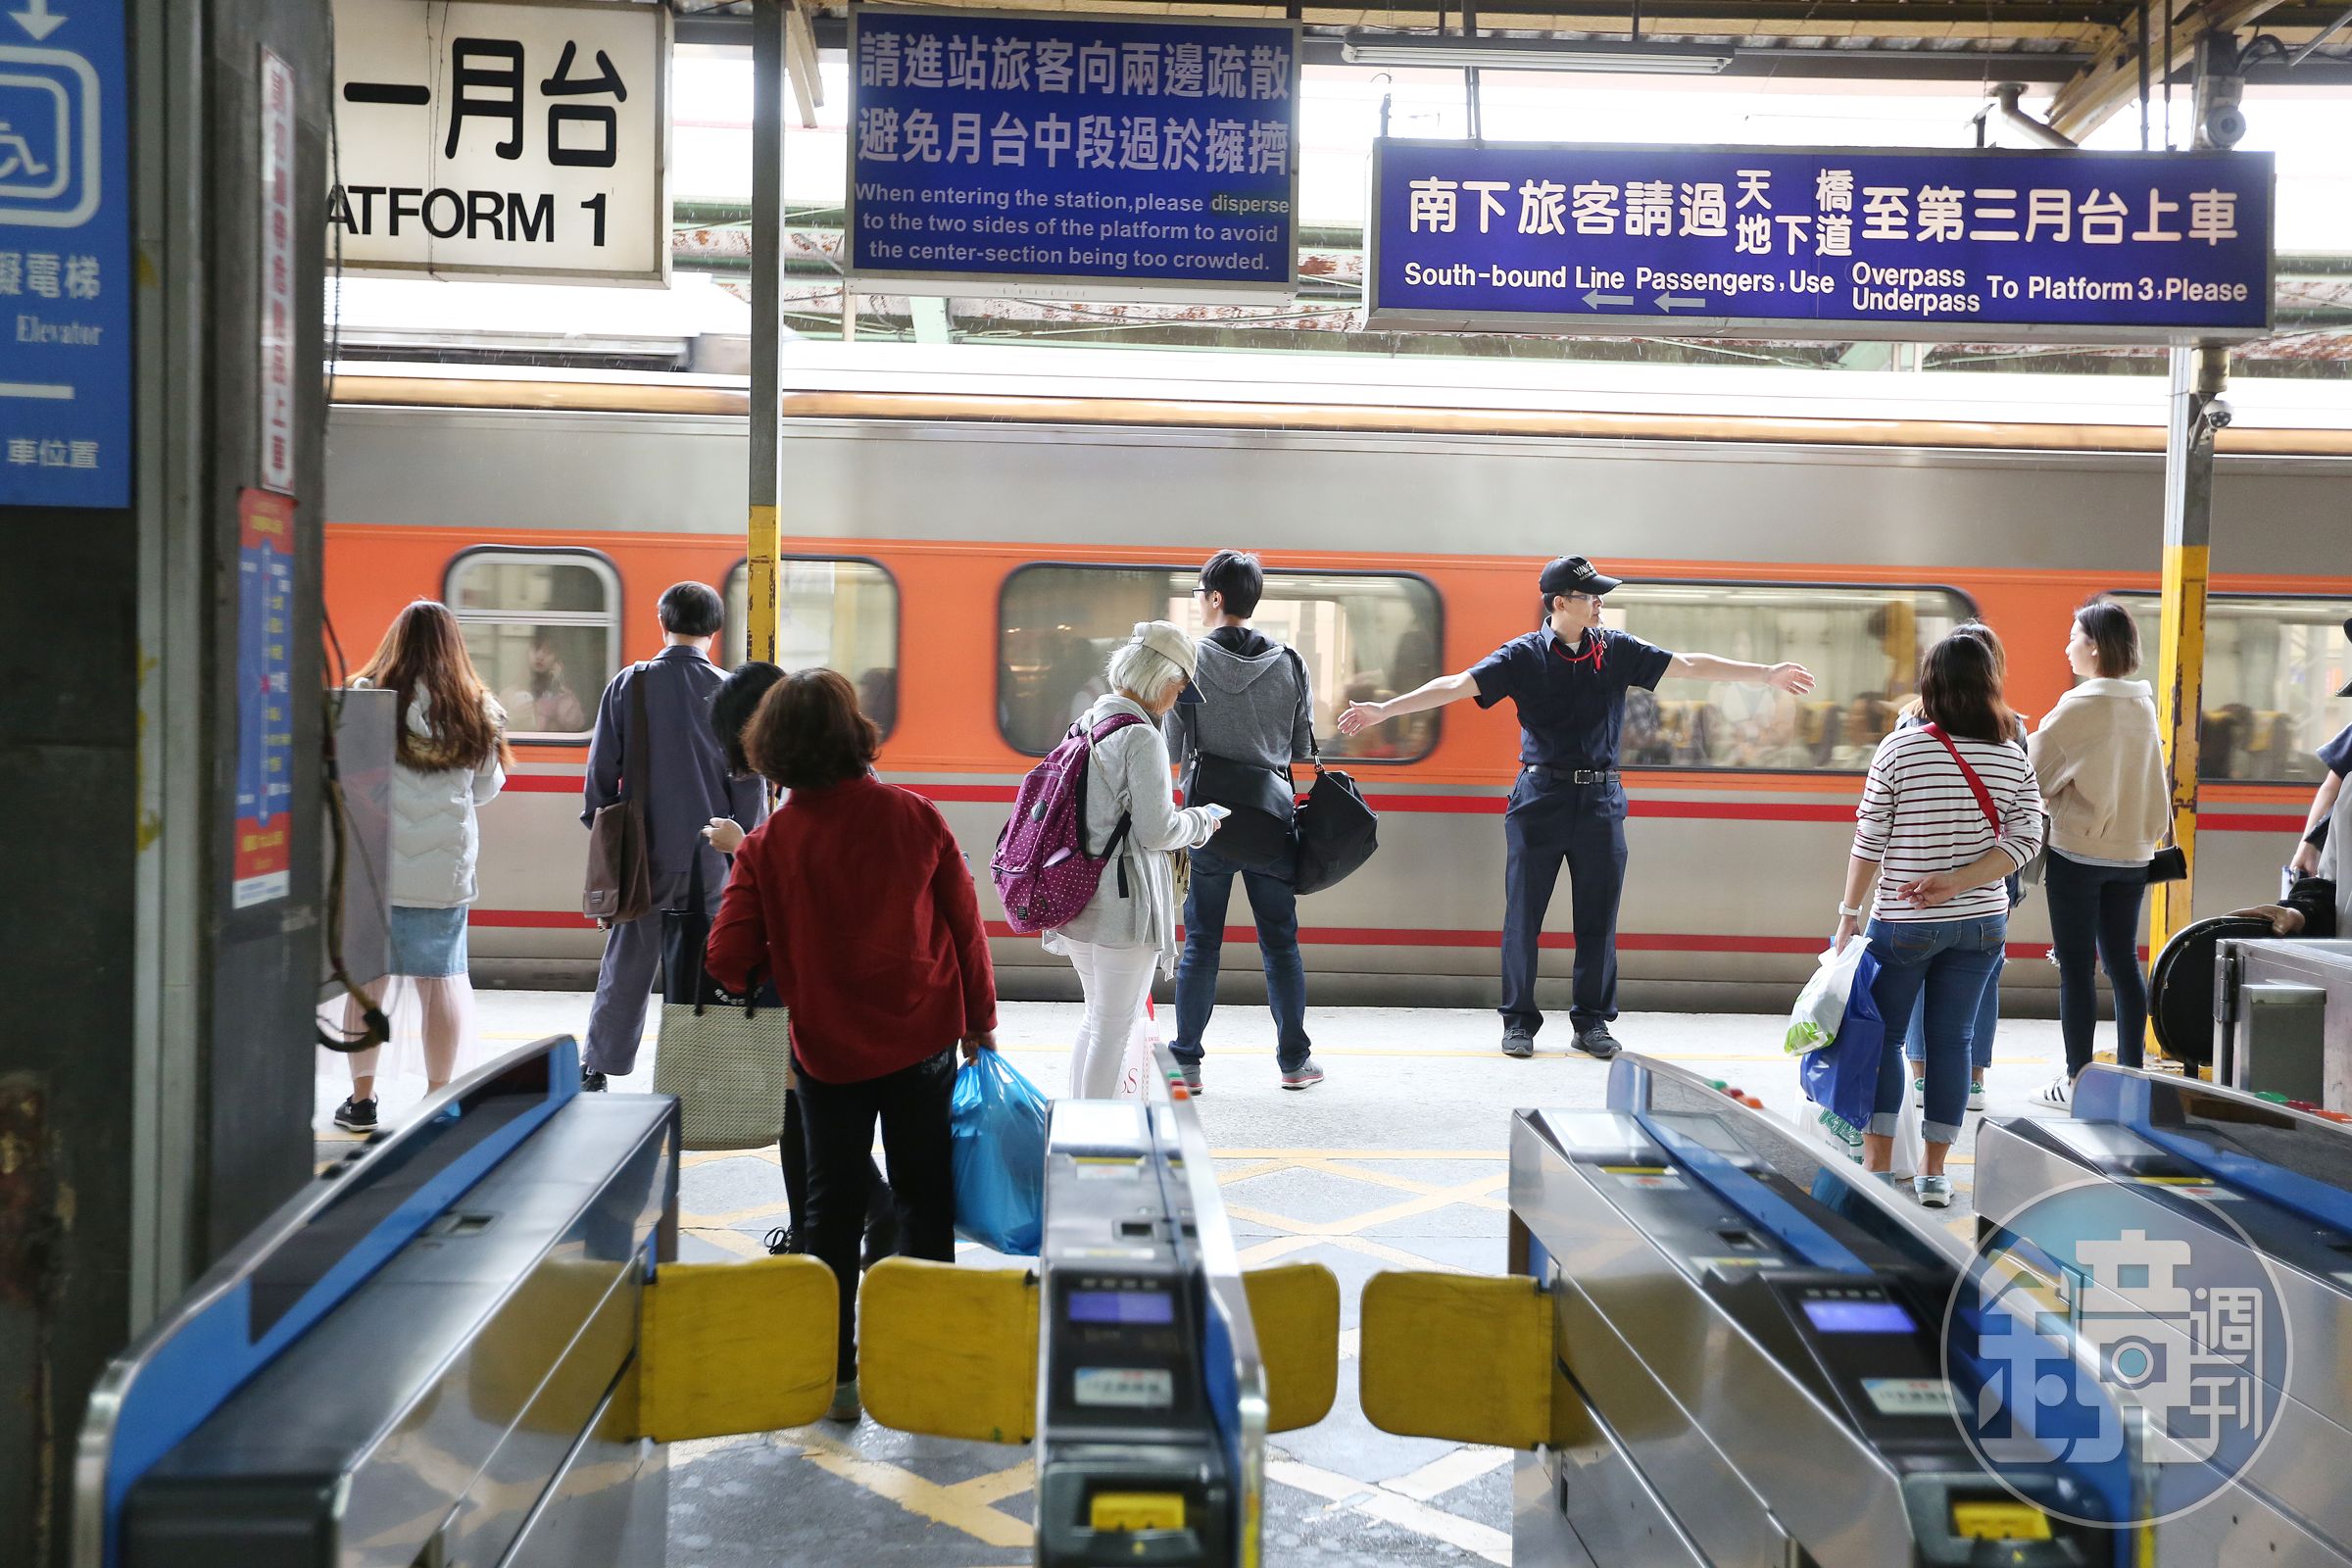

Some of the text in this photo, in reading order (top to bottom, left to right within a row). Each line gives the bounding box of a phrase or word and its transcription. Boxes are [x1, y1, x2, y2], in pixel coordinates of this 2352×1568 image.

[858, 30, 1291, 101] 請進站旅客向兩邊疏散
[343, 36, 627, 169] 一月台
[858, 106, 1289, 175] 避免月台中段過於擁擠
[855, 182, 915, 202] When
[920, 187, 1009, 210] entering
[1014, 189, 1049, 207] the
[1211, 194, 1290, 216] disperse
[1408, 175, 1728, 238] 南下旅客請過
[1862, 185, 2239, 246] 至第三月台上車
[580, 193, 607, 247] 1
[862, 213, 1279, 243] to the two sides of the platform to avoid
[1736, 213, 1854, 258] 地下道
[869, 240, 1270, 270] the center-section being too crowded.
[1404, 262, 1566, 291] South-bound
[1576, 266, 1625, 290] Line
[1852, 261, 1966, 288] Overpass
[1986, 274, 2018, 299] To
[2029, 276, 2132, 301] Platform
[1852, 287, 1981, 316] Underpass
[16, 314, 103, 345] Elevator
